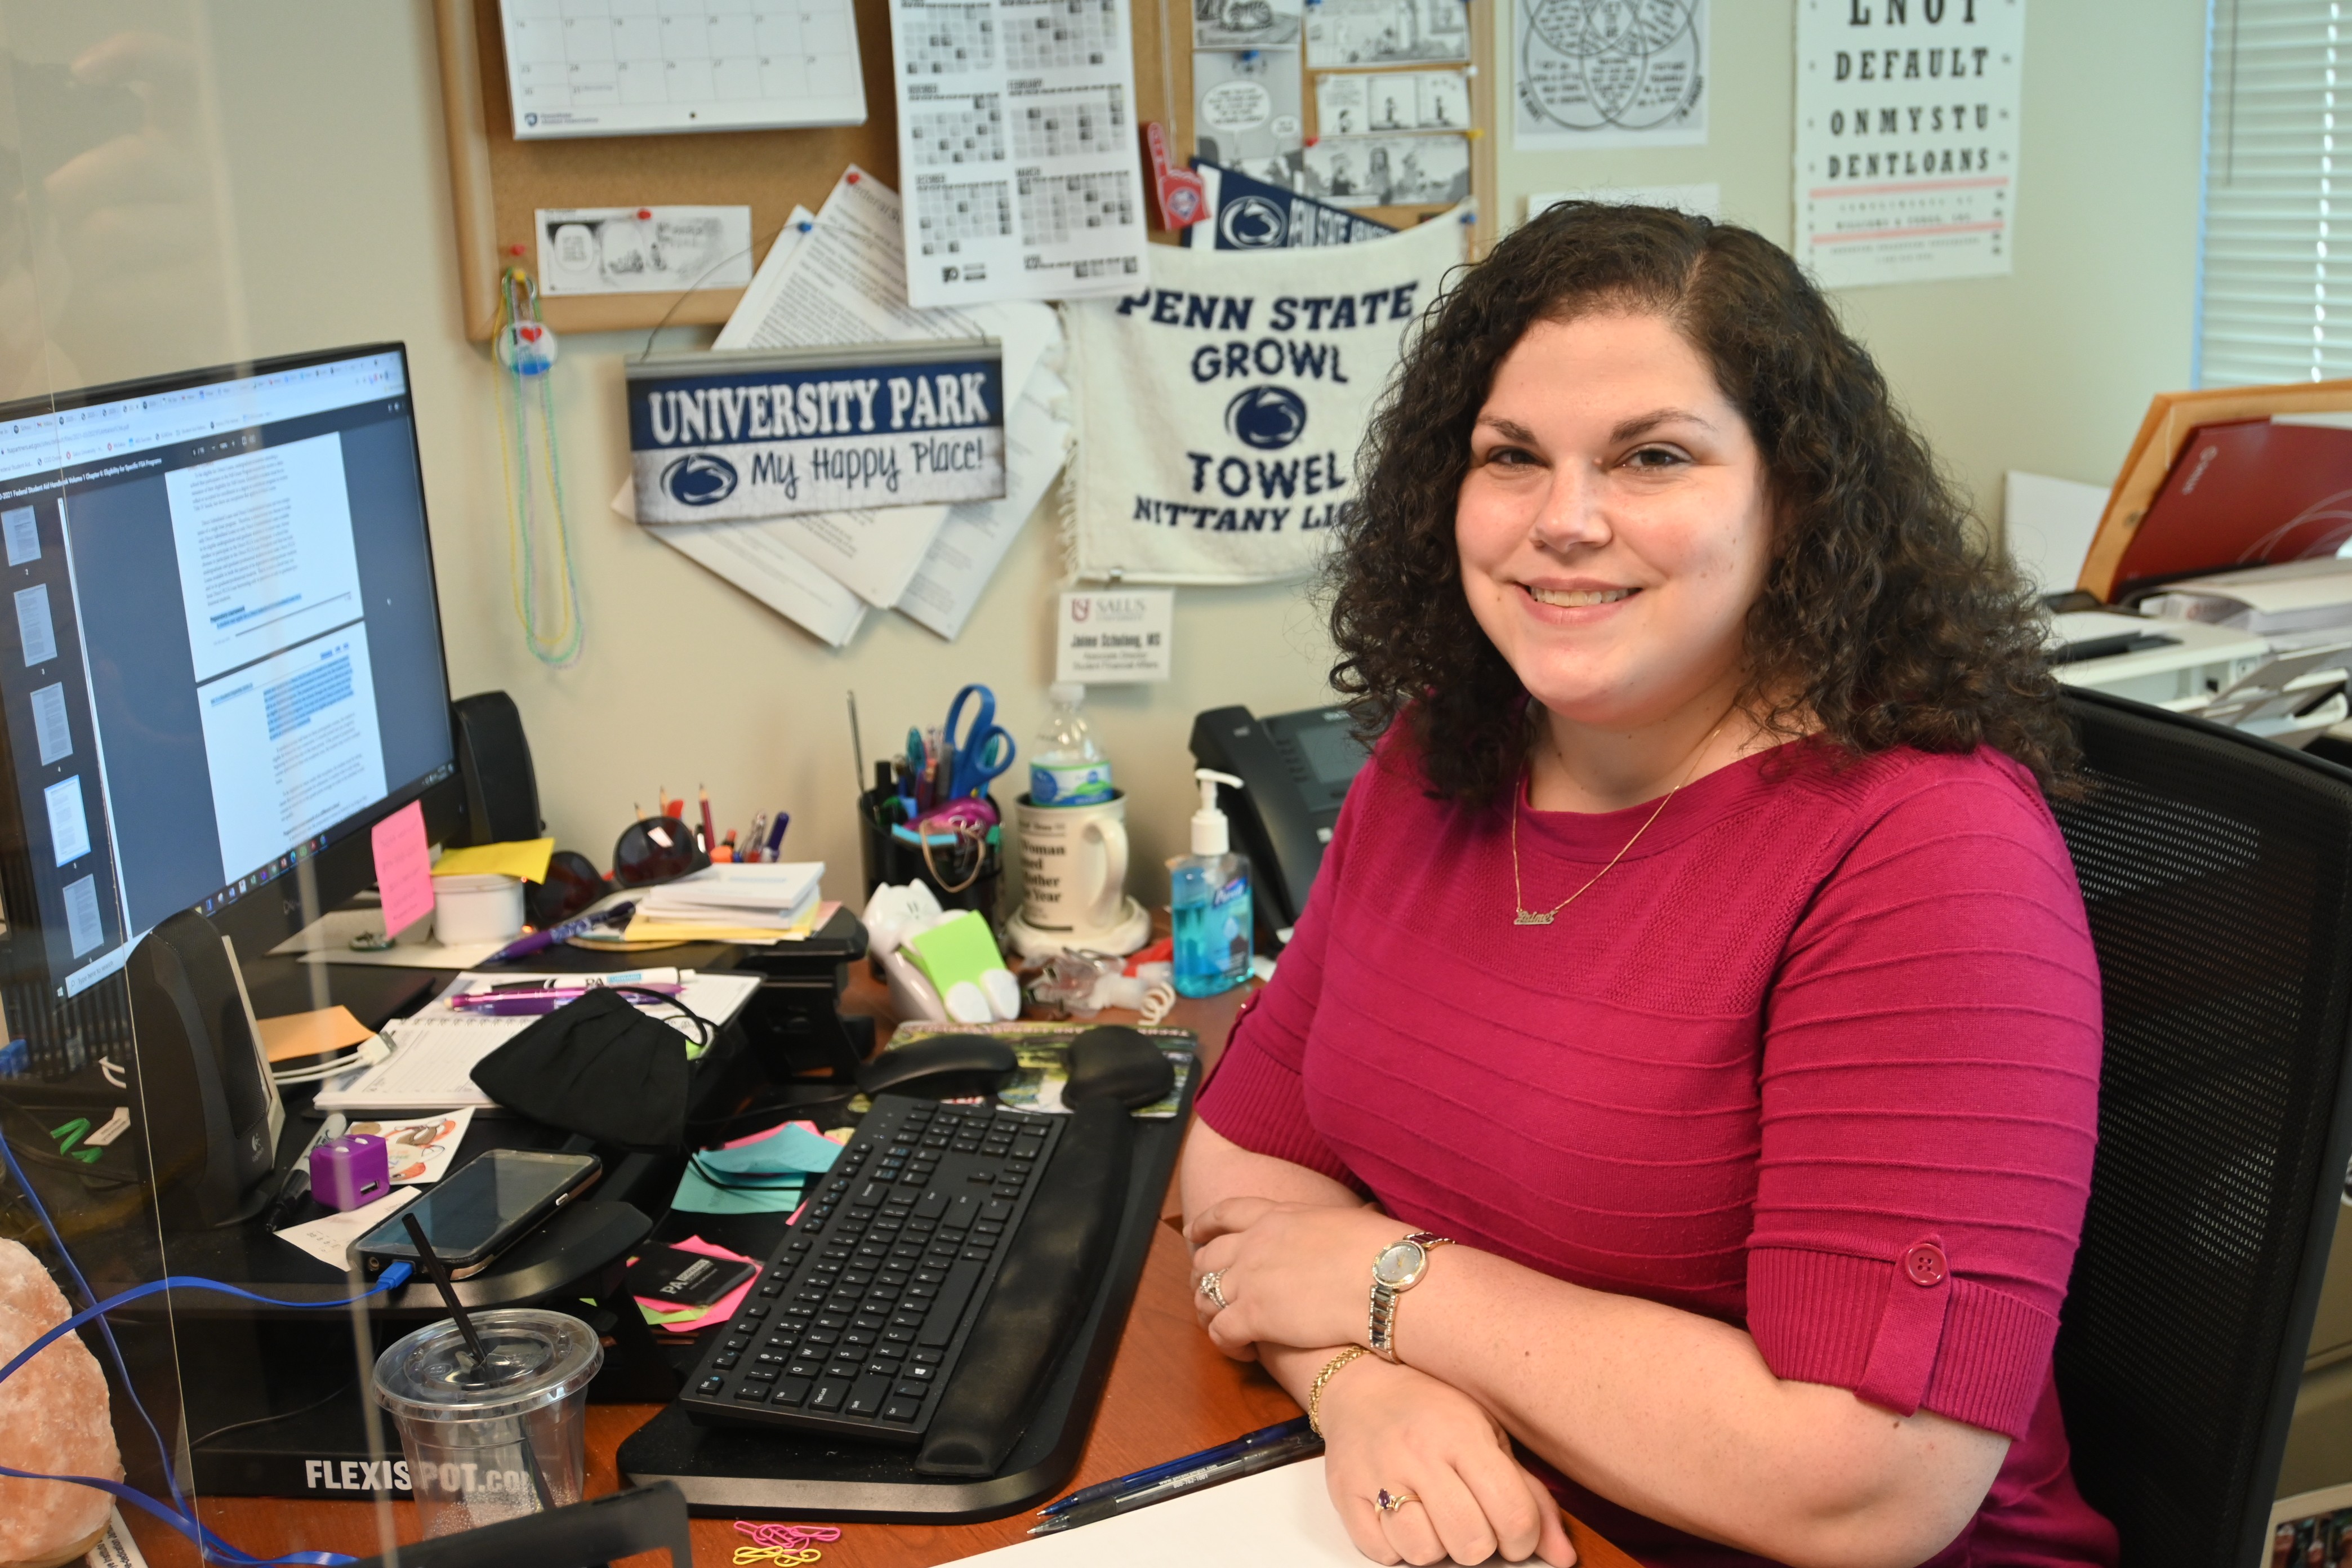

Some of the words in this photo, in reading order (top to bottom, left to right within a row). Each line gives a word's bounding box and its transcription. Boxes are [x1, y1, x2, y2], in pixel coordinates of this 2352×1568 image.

[1835, 47, 1988, 81] DEFAULT
[1830, 104, 1988, 136] ONMYSTU
[1828, 148, 1988, 179] DENTLOANS
[1116, 287, 1254, 332] PENN
[1269, 281, 1419, 332] STATE
[1191, 338, 1348, 385] GROWL
[648, 378, 880, 446] UNIVERSITY
[888, 372, 990, 431] PARK
[751, 452, 799, 500] My
[812, 445, 899, 493] Happy
[910, 437, 983, 474] Place!
[1186, 451, 1347, 500] TOWEL
[14, 487, 28, 496] Federal
[28, 484, 43, 493] Student
[1132, 494, 1290, 533] NITTANY
[78, 976, 87, 985] Type
[87, 970, 96, 979] here
[101, 961, 114, 971] search
[660, 1281, 689, 1294] PA
[852, 1400, 860, 1409] Shift
[1173, 1473, 1208, 1489] 800-762-1001
